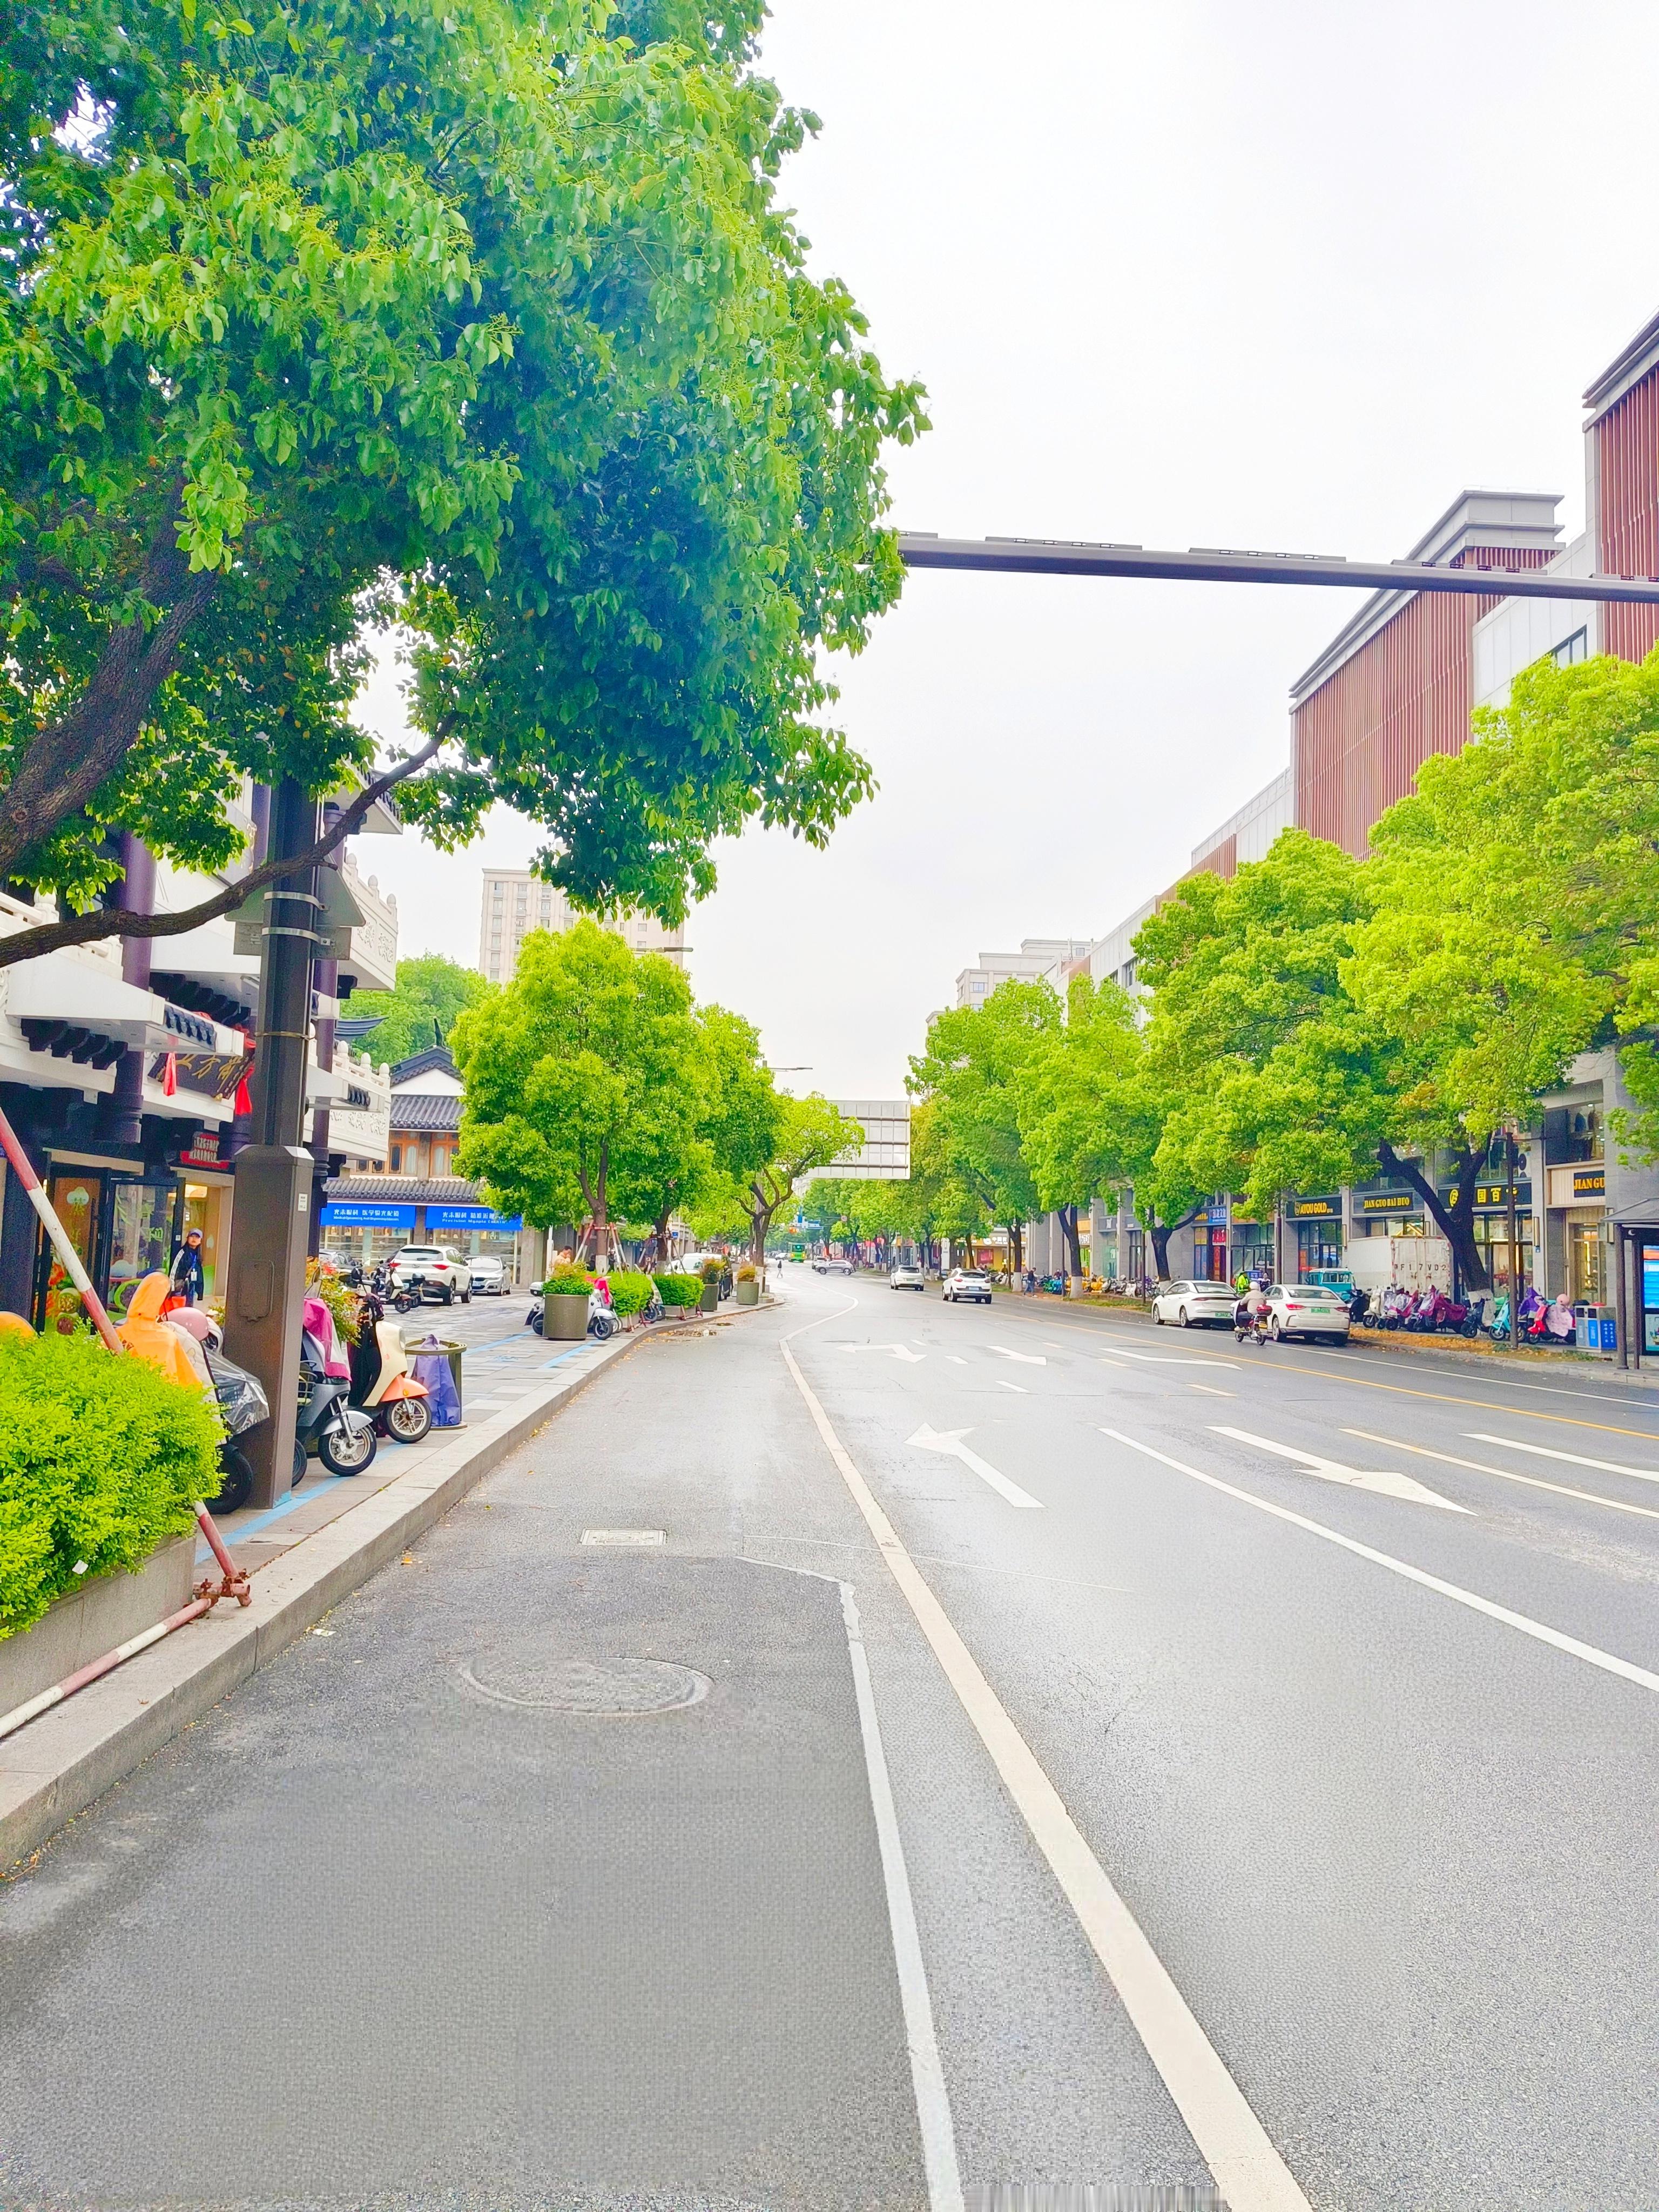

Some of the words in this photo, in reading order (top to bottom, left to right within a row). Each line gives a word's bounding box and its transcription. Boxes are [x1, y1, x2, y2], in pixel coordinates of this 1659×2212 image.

[1574, 1178, 1593, 1190] JIAN
[1313, 1202, 1327, 1213] GOLD
[1375, 1199, 1387, 1208] GUO
[1397, 1197, 1410, 1205] HUO
